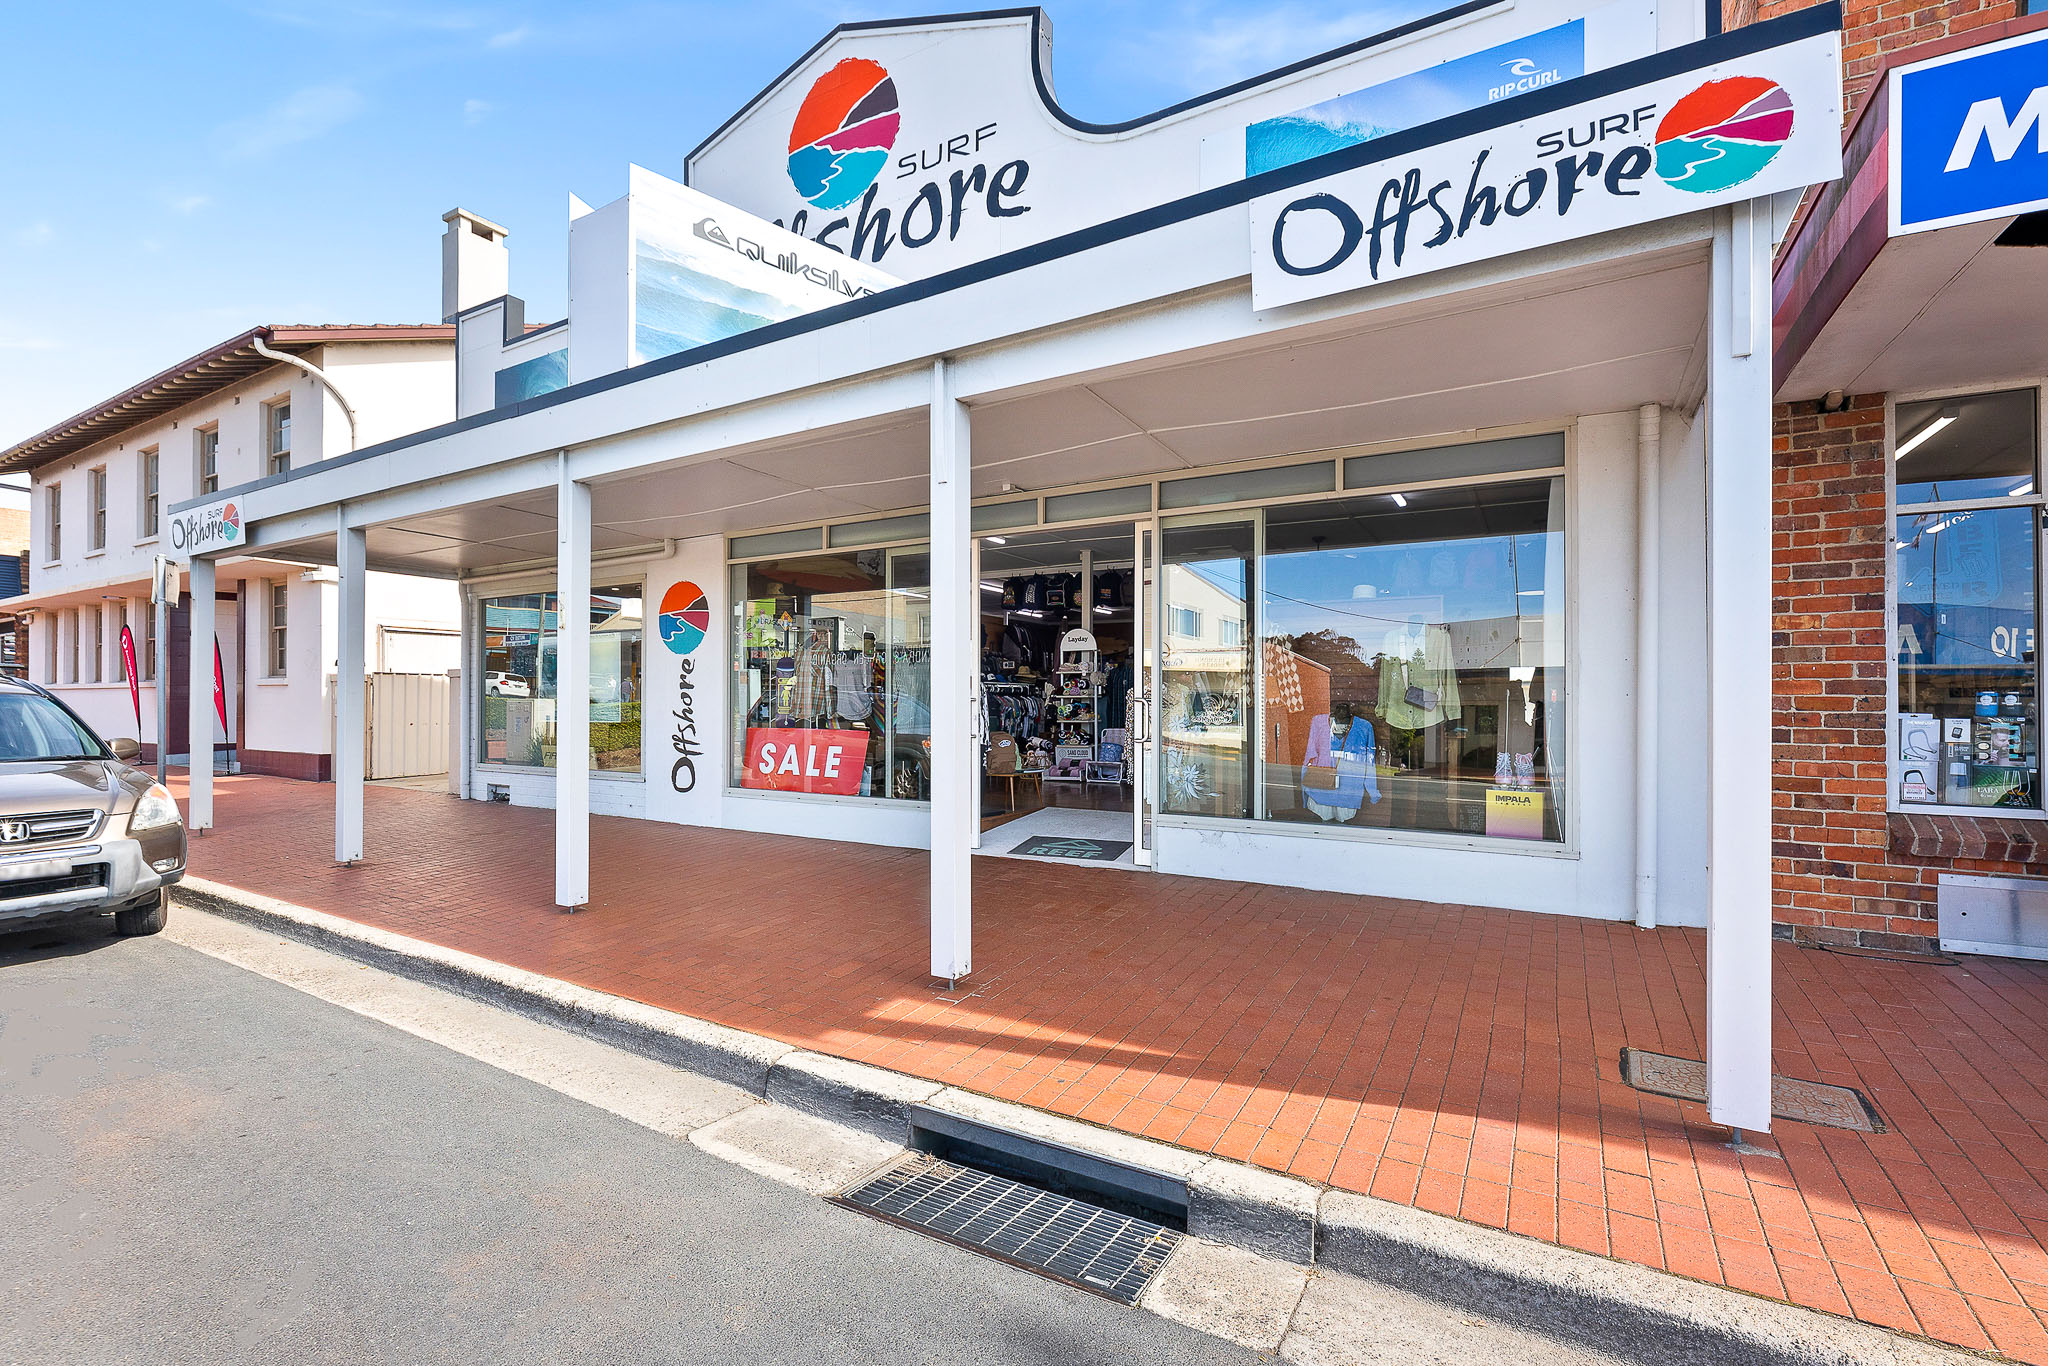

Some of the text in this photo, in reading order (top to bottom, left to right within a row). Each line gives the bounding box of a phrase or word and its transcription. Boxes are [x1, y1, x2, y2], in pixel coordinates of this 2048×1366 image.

[1489, 69, 1561, 100] RIP CURL
[896, 122, 997, 179] SURF
[1536, 104, 1657, 159] SURF
[772, 159, 1031, 263] shore
[1272, 146, 1653, 281] Offshore
[172, 513, 223, 554] Offshore
[208, 507, 223, 520] SURF
[671, 658, 704, 793] Offshore
[759, 742, 843, 779] SALE
[1495, 795, 1532, 803] IMPALA
[1027, 847, 1103, 858] REEF
